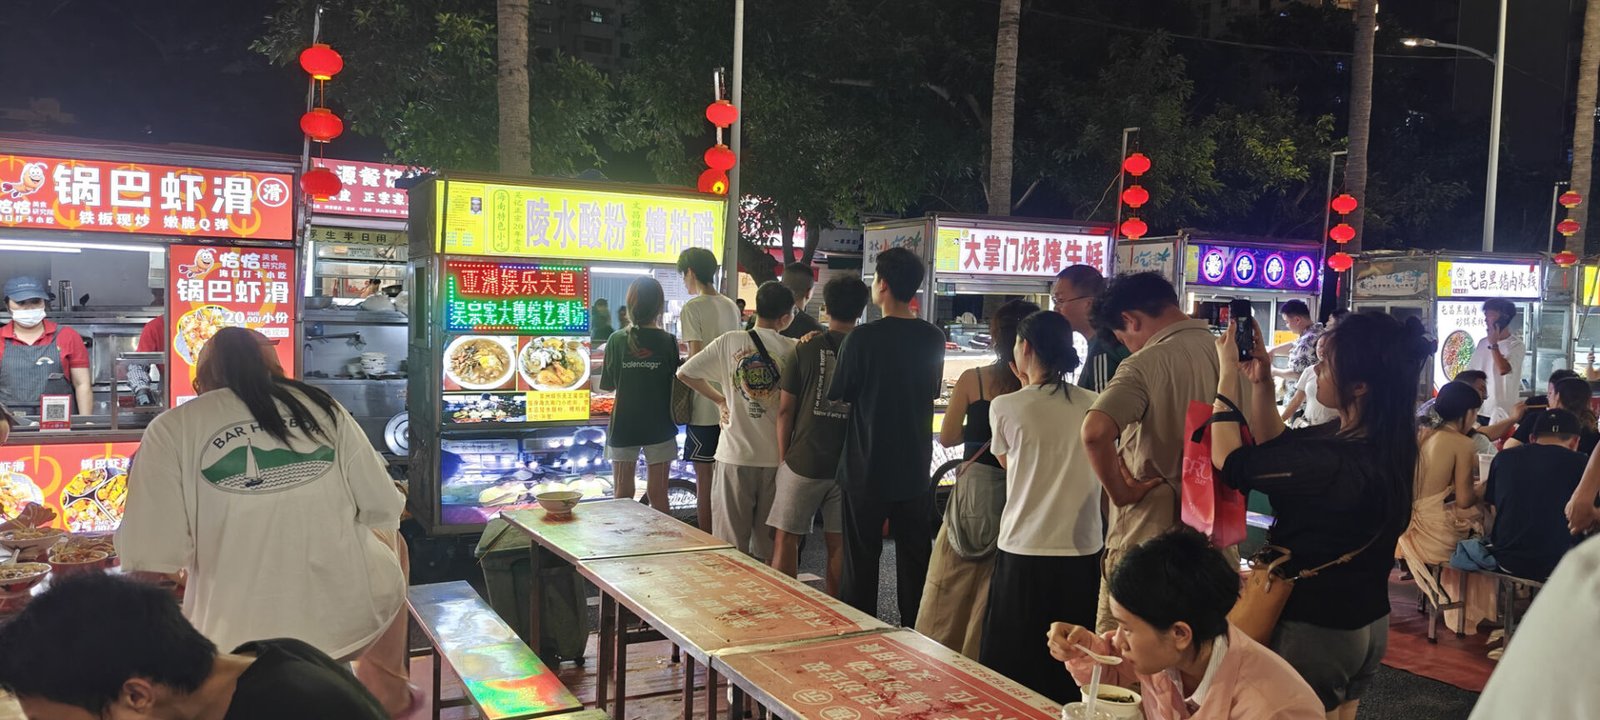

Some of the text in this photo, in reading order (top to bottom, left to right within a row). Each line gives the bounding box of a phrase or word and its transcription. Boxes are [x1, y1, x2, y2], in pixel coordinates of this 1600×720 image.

[53, 164, 252, 214] 锅巴虾滑
[0, 214, 54, 224] 口打卡小吃
[79, 211, 150, 227] 铁板现炒
[163, 215, 229, 231] 嫩脆Q弹
[526, 197, 627, 251] 陵水酸粉
[645, 206, 714, 254] 糟粕醋
[964, 234, 1103, 273] 大掌门烧烤生蚝
[176, 278, 289, 303] 锅巴虾滑
[461, 268, 576, 295] 亚洲娱乐天皇
[212, 426, 247, 449] BAR
[800, 661, 901, 716] 不乱扔垃圾
